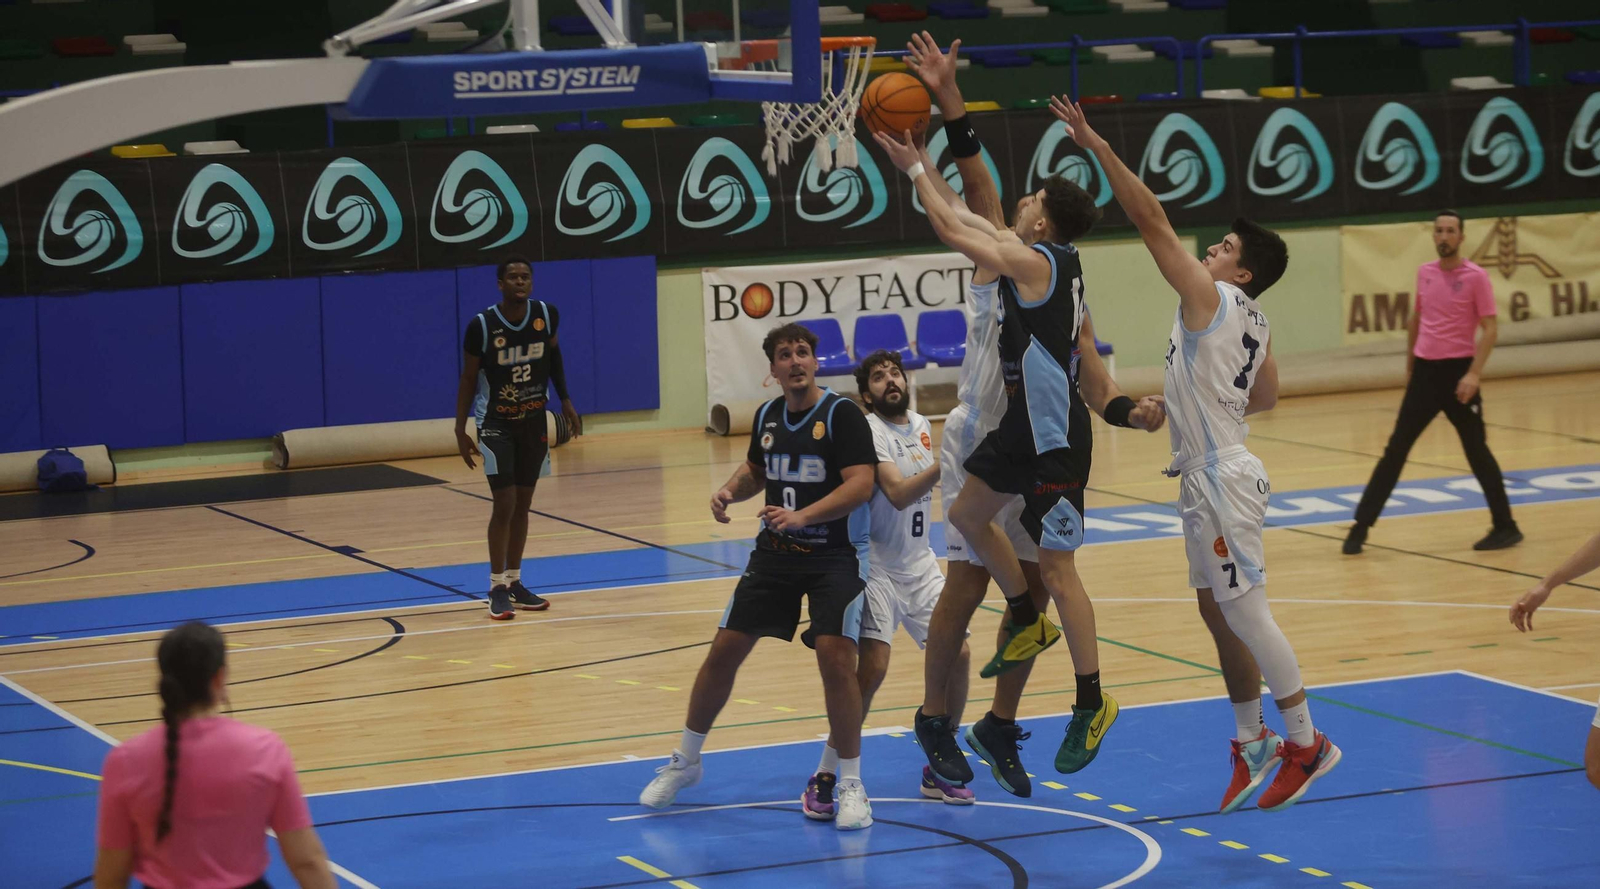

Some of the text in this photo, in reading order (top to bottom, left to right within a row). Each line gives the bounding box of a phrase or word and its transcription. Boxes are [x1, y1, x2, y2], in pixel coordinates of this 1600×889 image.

[857, 267, 974, 311] FACT
[1348, 291, 1411, 333] AM
[497, 341, 545, 366] ULB
[1233, 331, 1260, 390] 7
[511, 363, 532, 383] 22
[764, 453, 826, 483] ULB
[782, 486, 796, 511] 0
[911, 510, 924, 537] 8
[1221, 562, 1239, 589] 7
